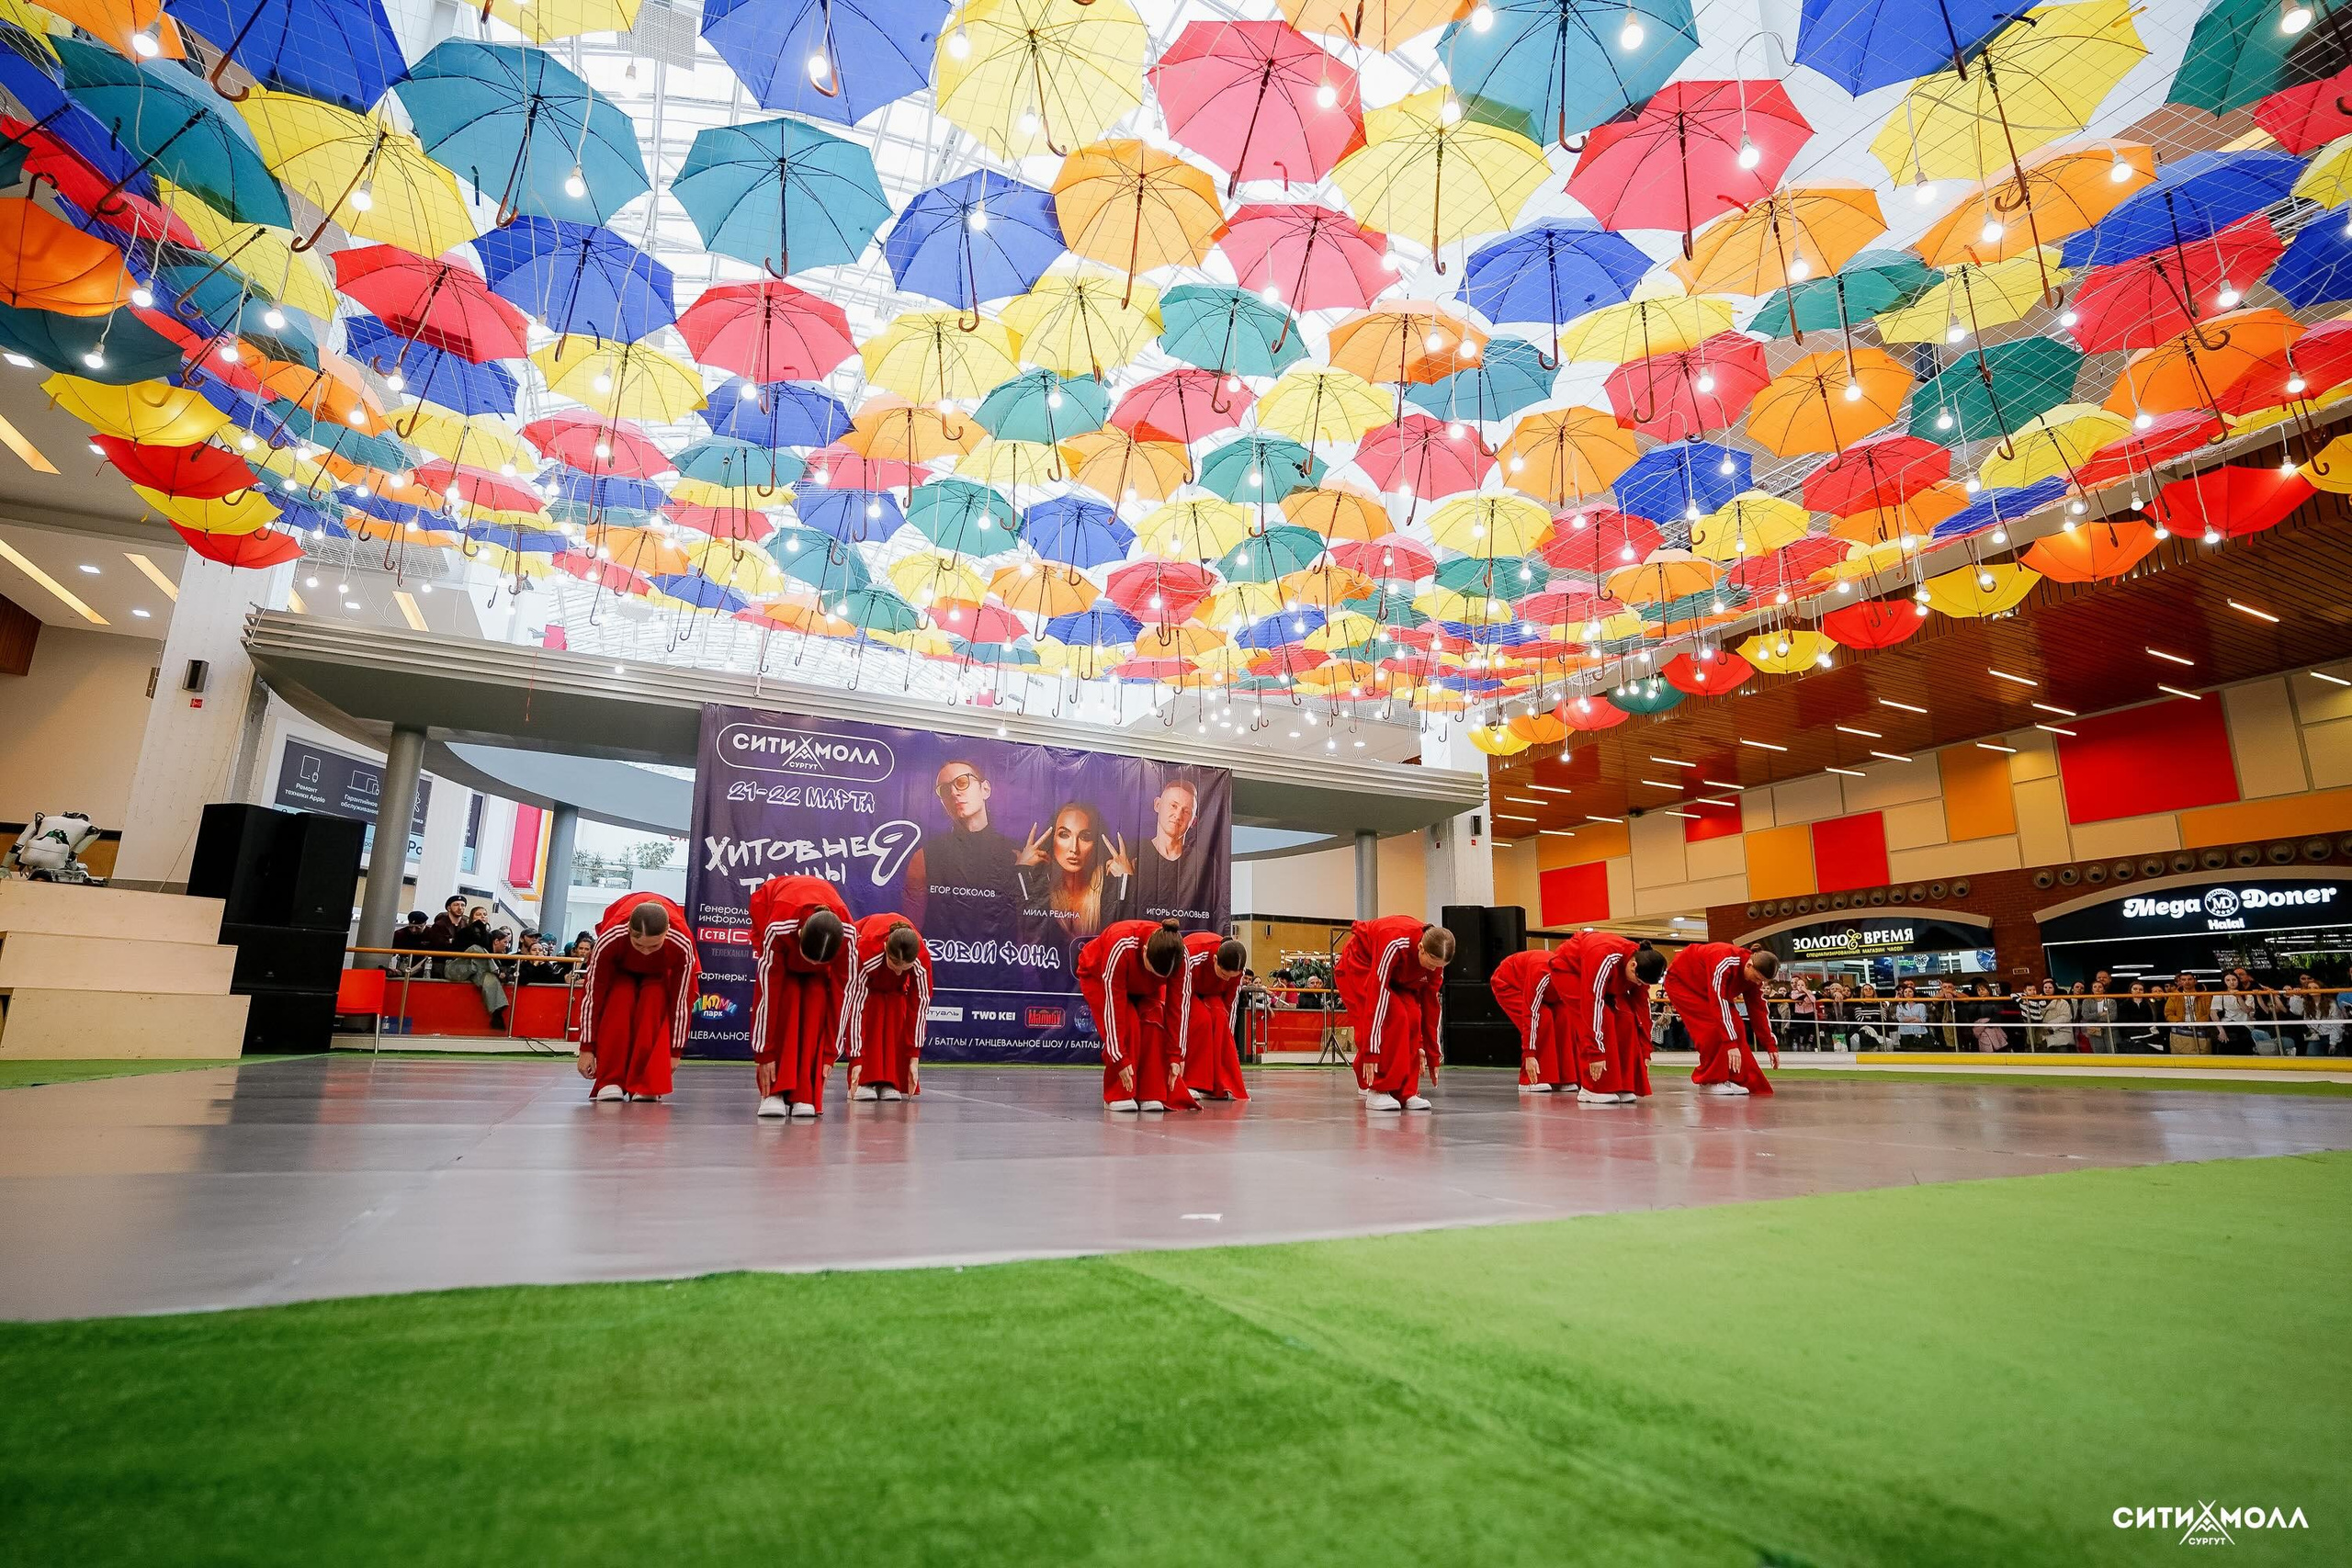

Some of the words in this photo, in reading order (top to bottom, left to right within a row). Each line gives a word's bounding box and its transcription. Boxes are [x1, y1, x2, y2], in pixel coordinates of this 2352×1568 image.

[732, 733, 796, 754] СИТИ
[814, 742, 880, 765] МОЛЛ
[789, 761, 819, 770] СУРГУТ
[296, 783, 318, 794] Ремонт
[727, 781, 801, 806] 21-22
[806, 785, 875, 814] МАРТА
[930, 886, 951, 896] ЕГОР
[952, 886, 996, 897] СОКОЛОВ
[2123, 898, 2201, 919] Mega
[2240, 886, 2337, 908] Doner
[1023, 908, 1048, 918] МИЛА
[1049, 909, 1081, 919] РЕДИНА
[1146, 908, 1170, 917] ИГОРЬ
[1171, 908, 1210, 919] СОЛОВЬЕВ
[2207, 917, 2245, 930] Halal
[1792, 934, 1849, 950] ЗОЛОТО
[1863, 928, 1914, 944] ВРЕМЯ
[922, 939, 997, 964] ЗОВОЙ
[999, 941, 1060, 969] ФОНД
[971, 1010, 996, 1020] TWO
[998, 1011, 1016, 1021] KEI
[934, 1037, 967, 1045] БАТТЛЫ
[975, 1038, 1041, 1048] ТАНЦЕВАЛЬНОЕ
[1042, 1040, 1064, 1048] ШОУ
[1070, 1041, 1100, 1049] БАТТЛЫ
